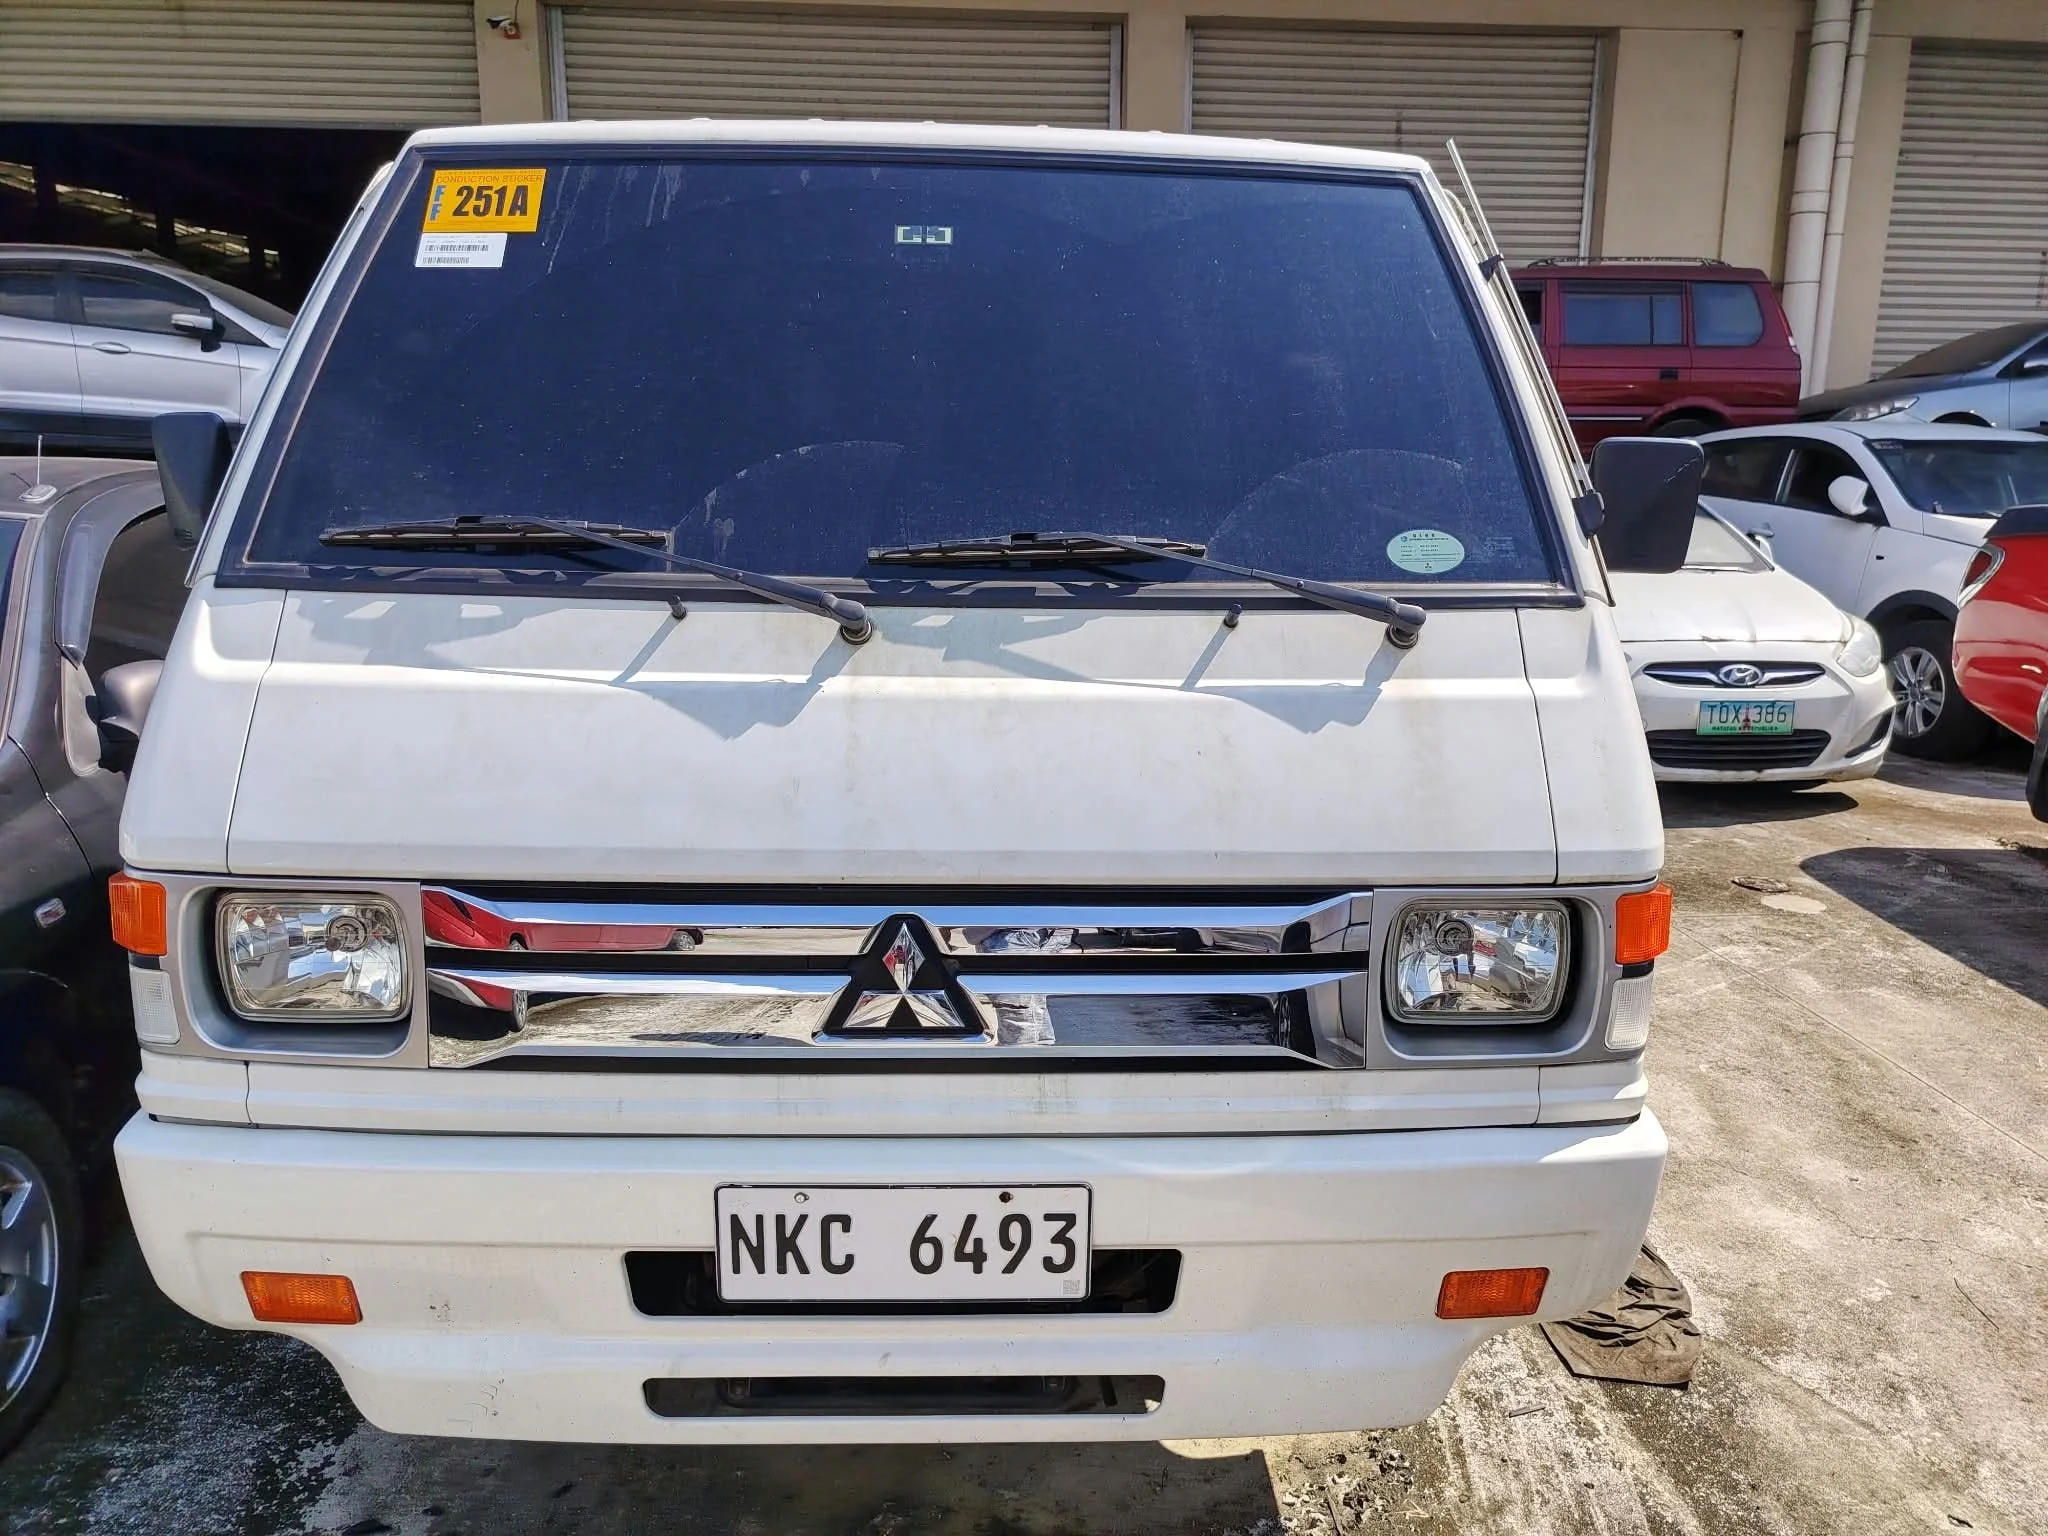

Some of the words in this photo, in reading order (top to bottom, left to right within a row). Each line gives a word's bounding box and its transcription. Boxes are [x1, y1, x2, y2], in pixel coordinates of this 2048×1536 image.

[437, 175, 499, 183] CONDUCTION
[453, 185, 529, 216] 251A
[1753, 705, 1787, 723] 386
[730, 1213, 855, 1275] NKC
[909, 1212, 1077, 1275] 6493
